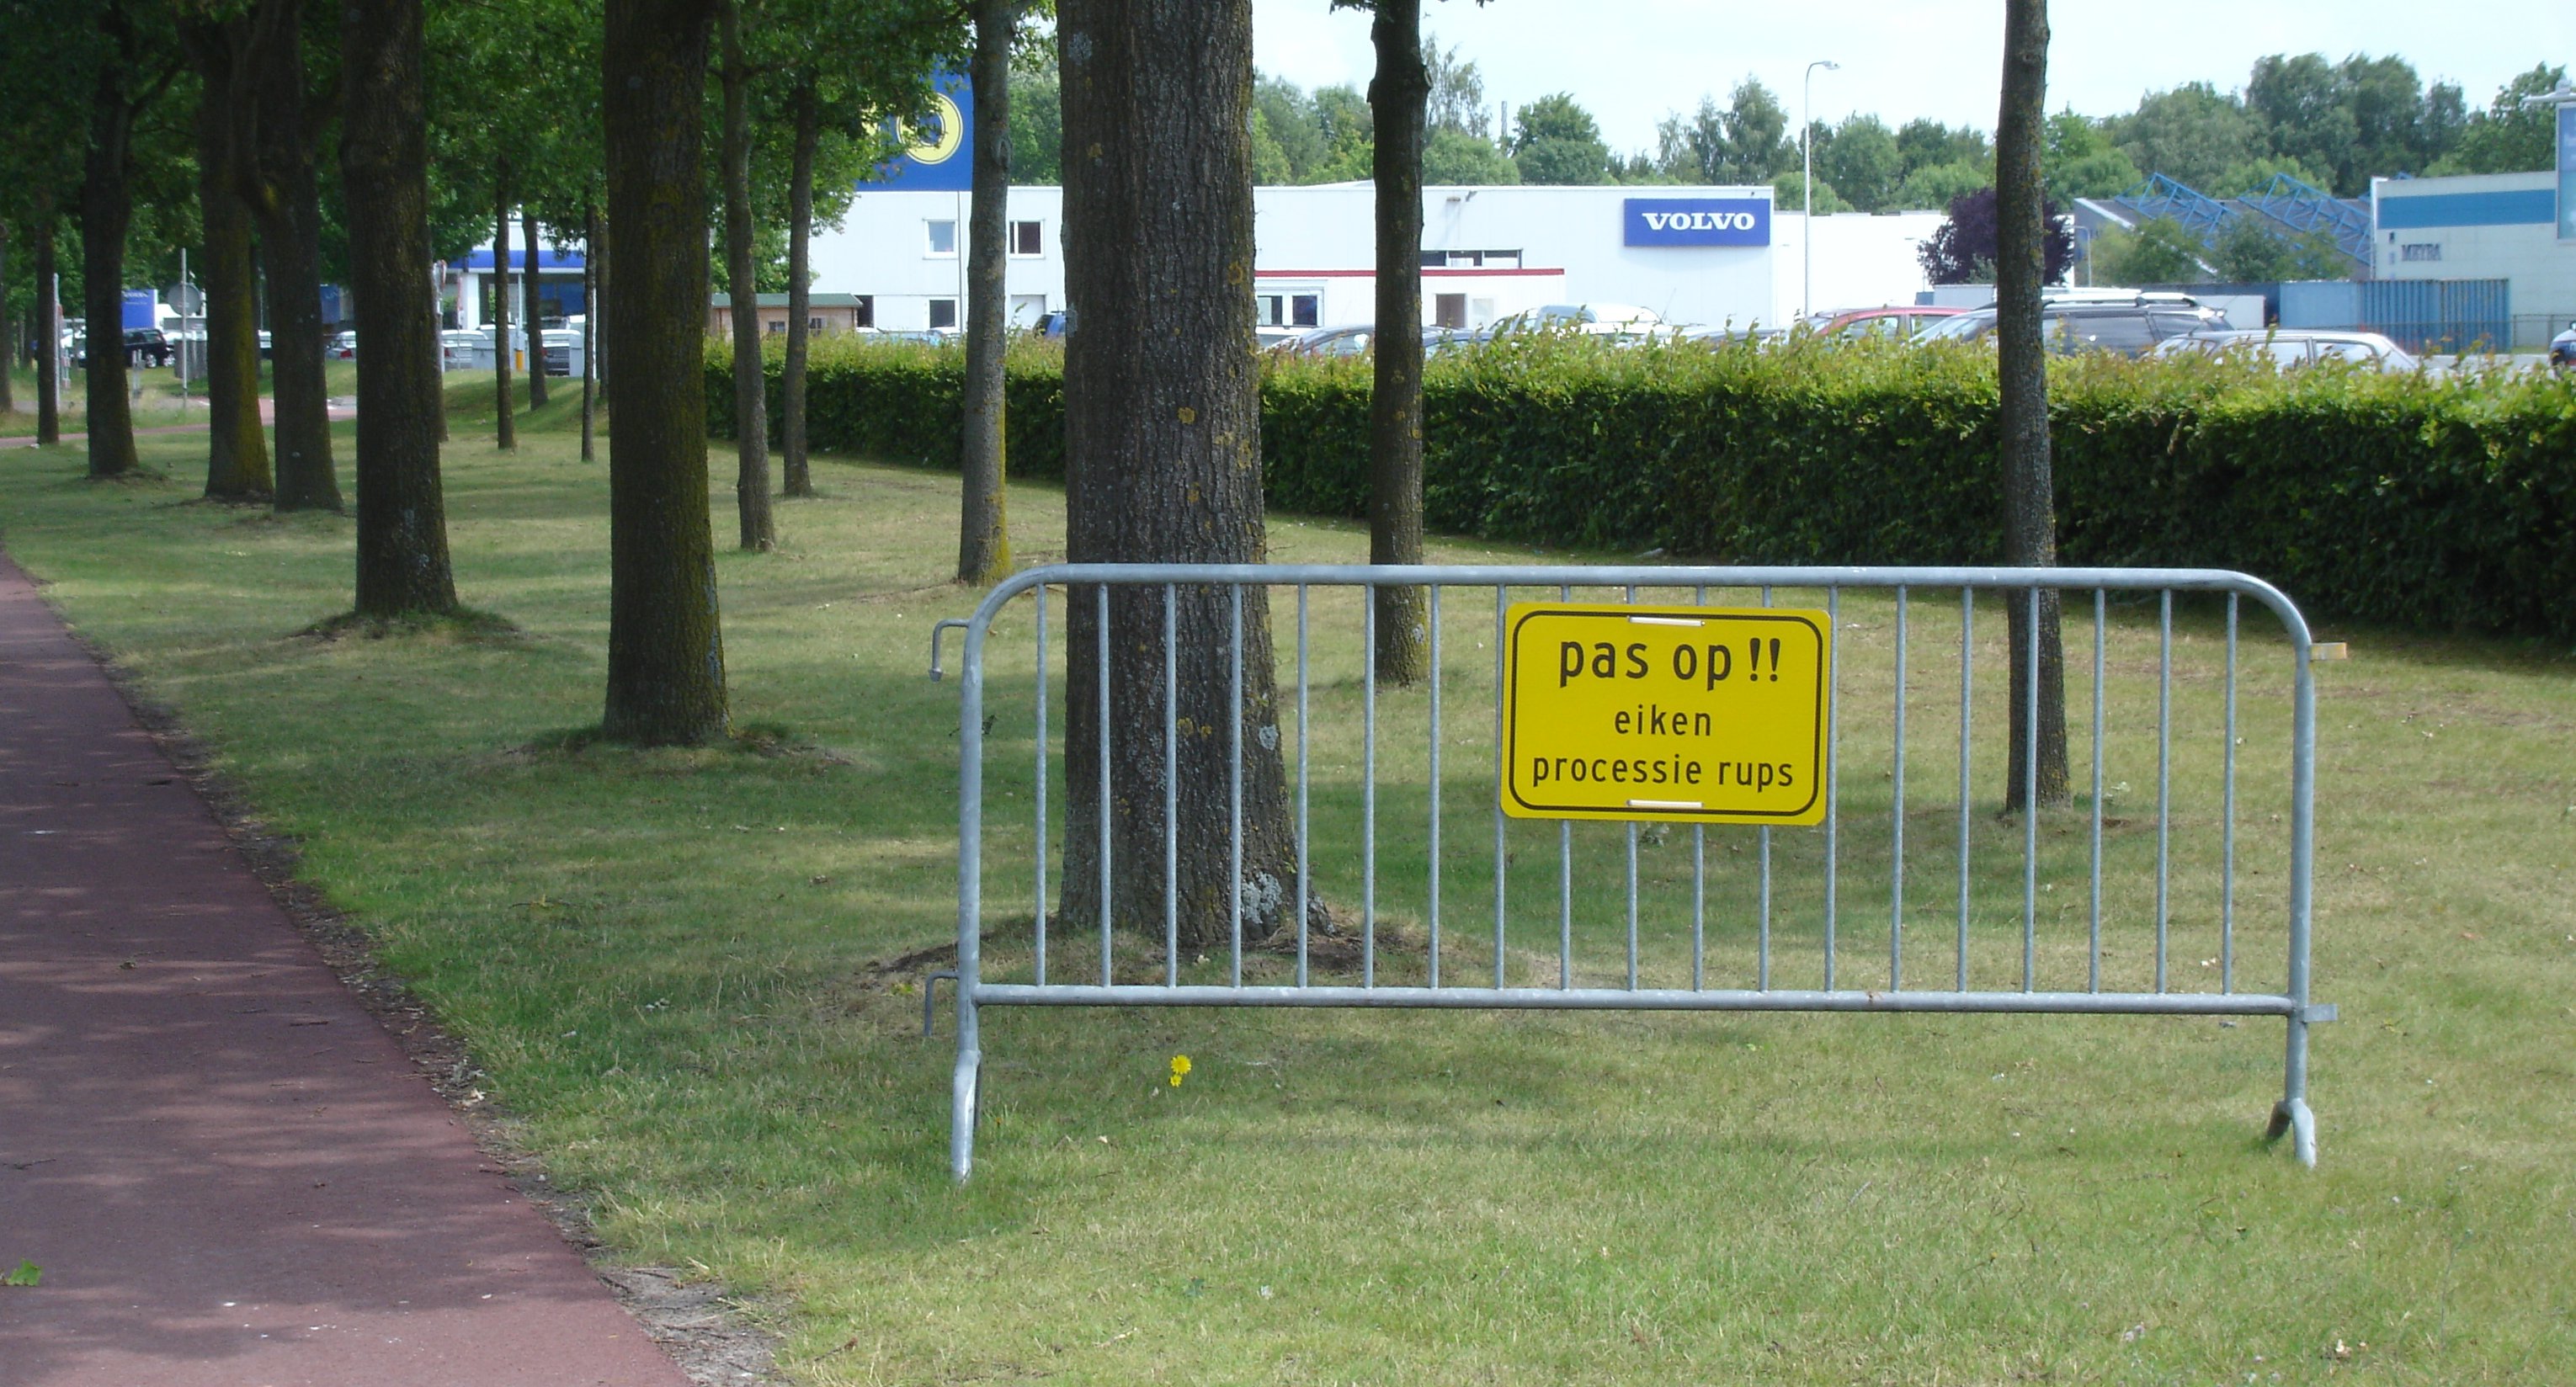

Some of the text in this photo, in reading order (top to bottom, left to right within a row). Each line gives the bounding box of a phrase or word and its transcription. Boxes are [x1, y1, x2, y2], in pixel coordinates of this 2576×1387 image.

[1642, 212, 1755, 231] VOLVO
[1560, 640, 1649, 688] pas
[1615, 704, 1711, 736] eiken
[1533, 753, 1793, 793] processie rups
